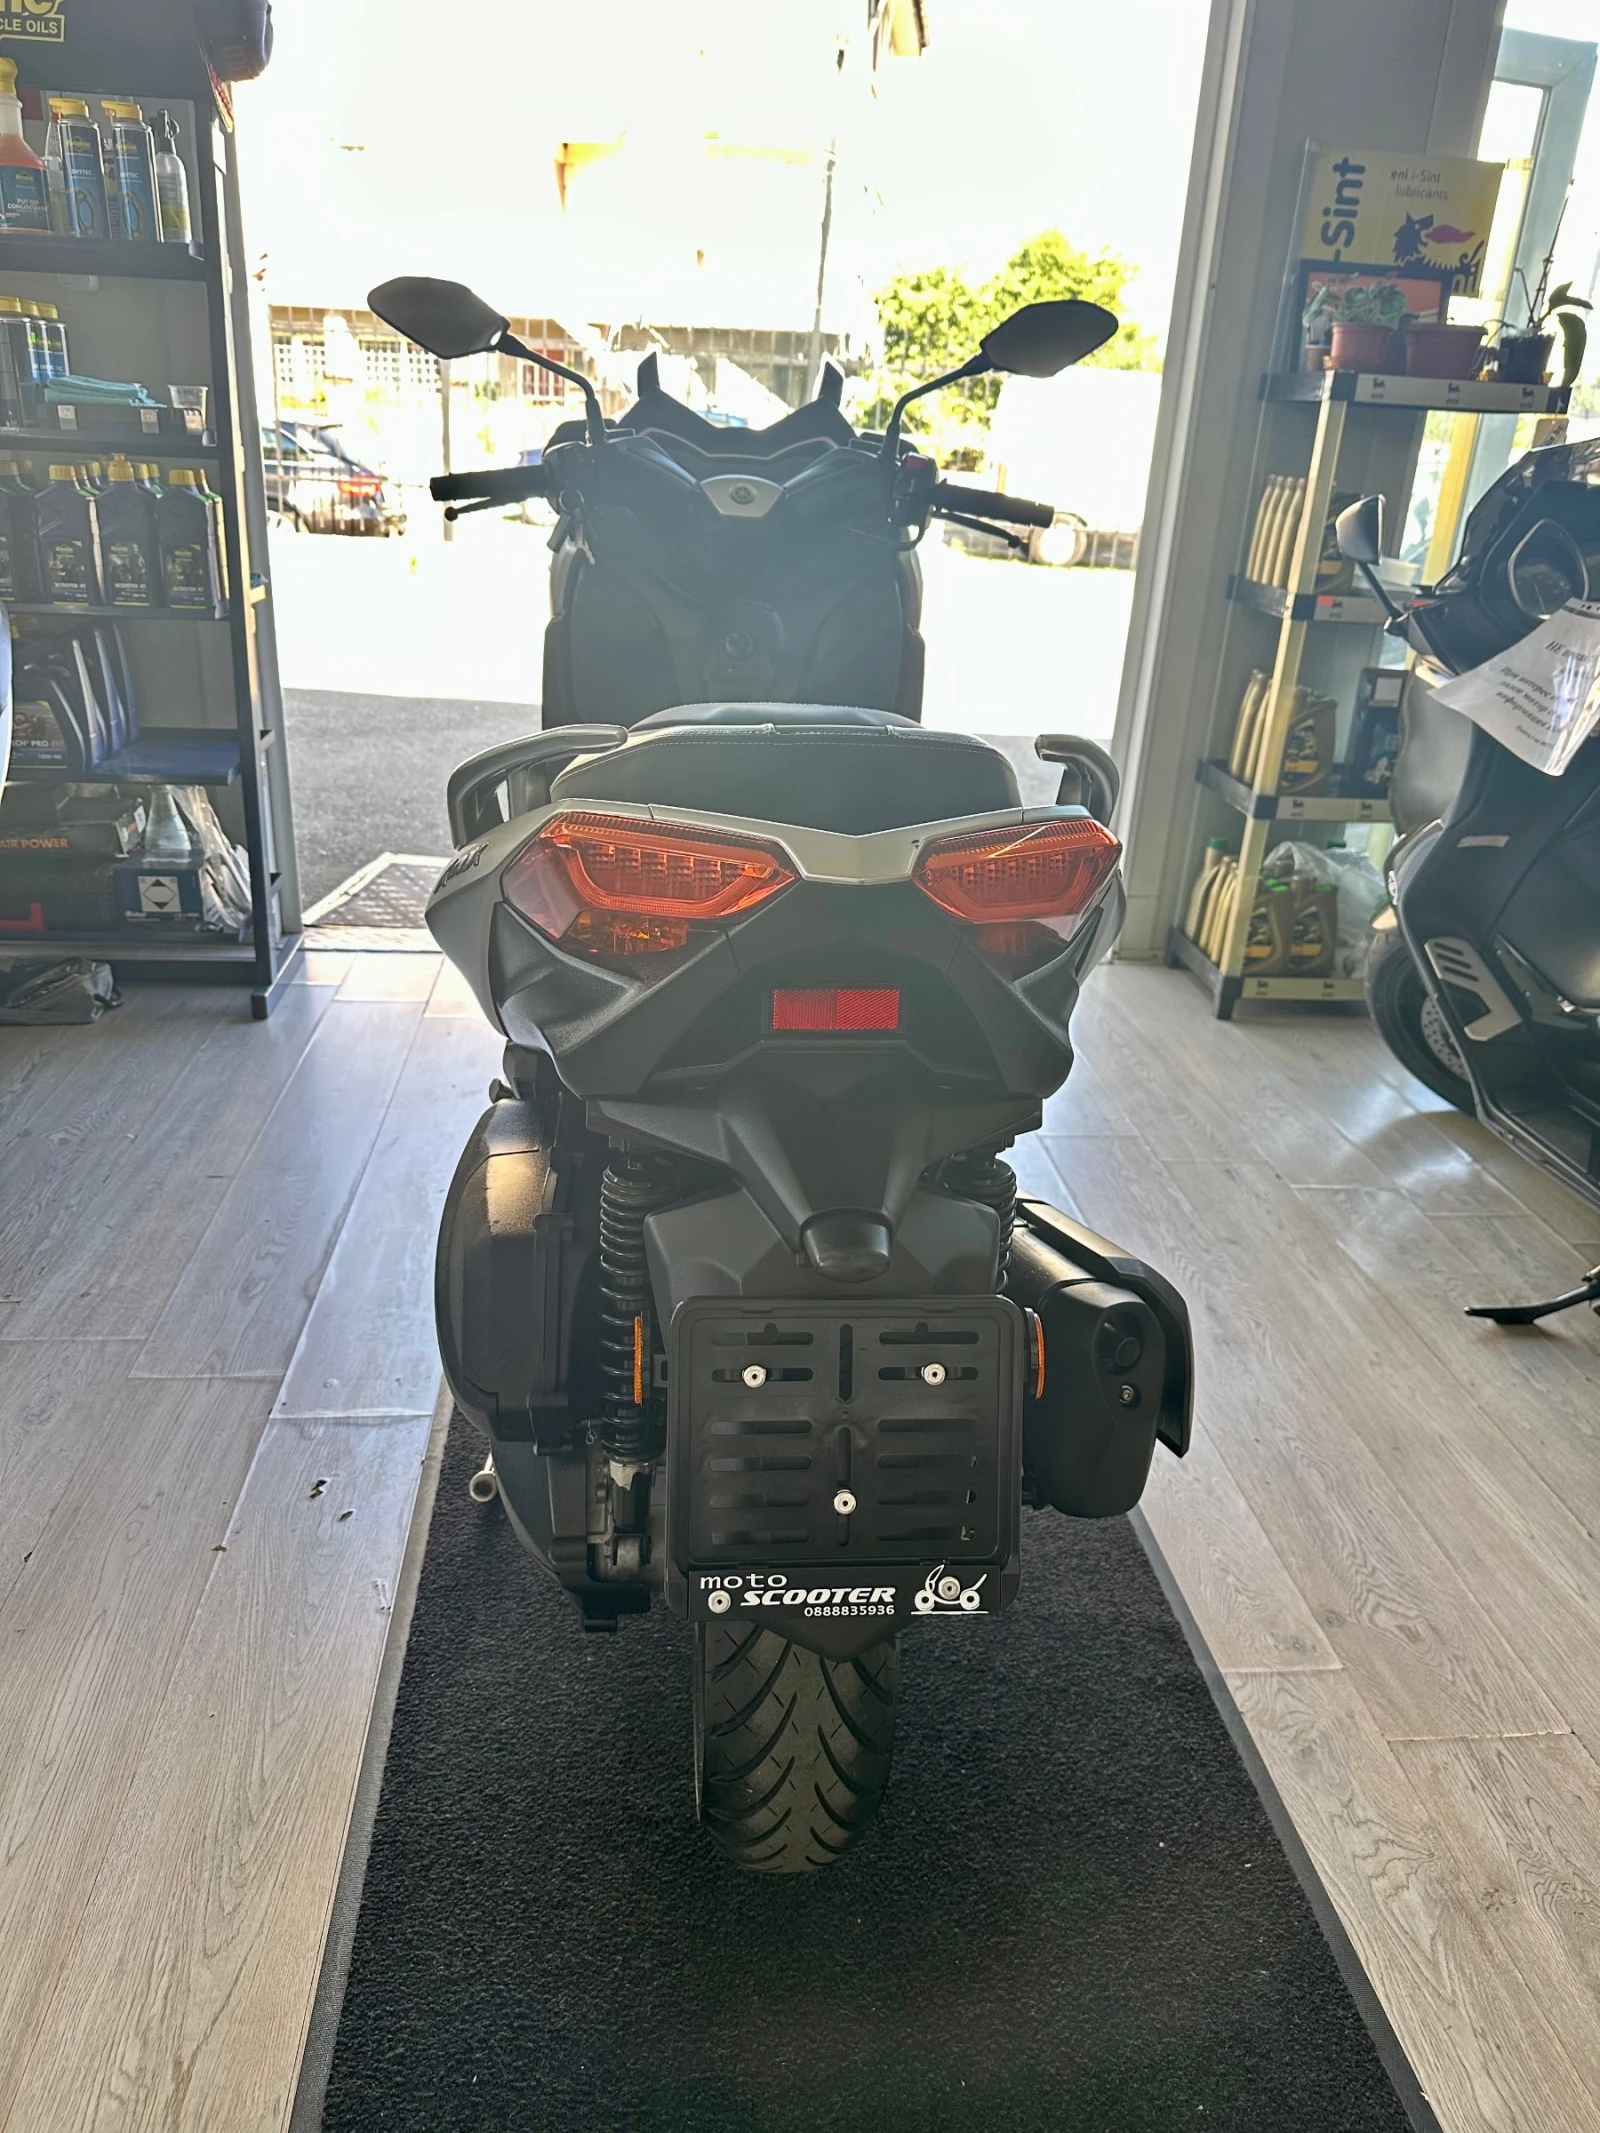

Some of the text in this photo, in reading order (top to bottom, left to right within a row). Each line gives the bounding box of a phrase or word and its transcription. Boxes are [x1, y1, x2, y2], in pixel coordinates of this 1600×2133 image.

[26, 20, 58, 34] OILS
[1391, 169, 1441, 184] eni i-Sint
[1395, 187, 1448, 201] lubricants
[22, 838, 69, 848] POWER
[700, 1573, 787, 1589] moto
[740, 1587, 896, 1606] SCOOTER
[804, 1605, 895, 1617] 0888835936
